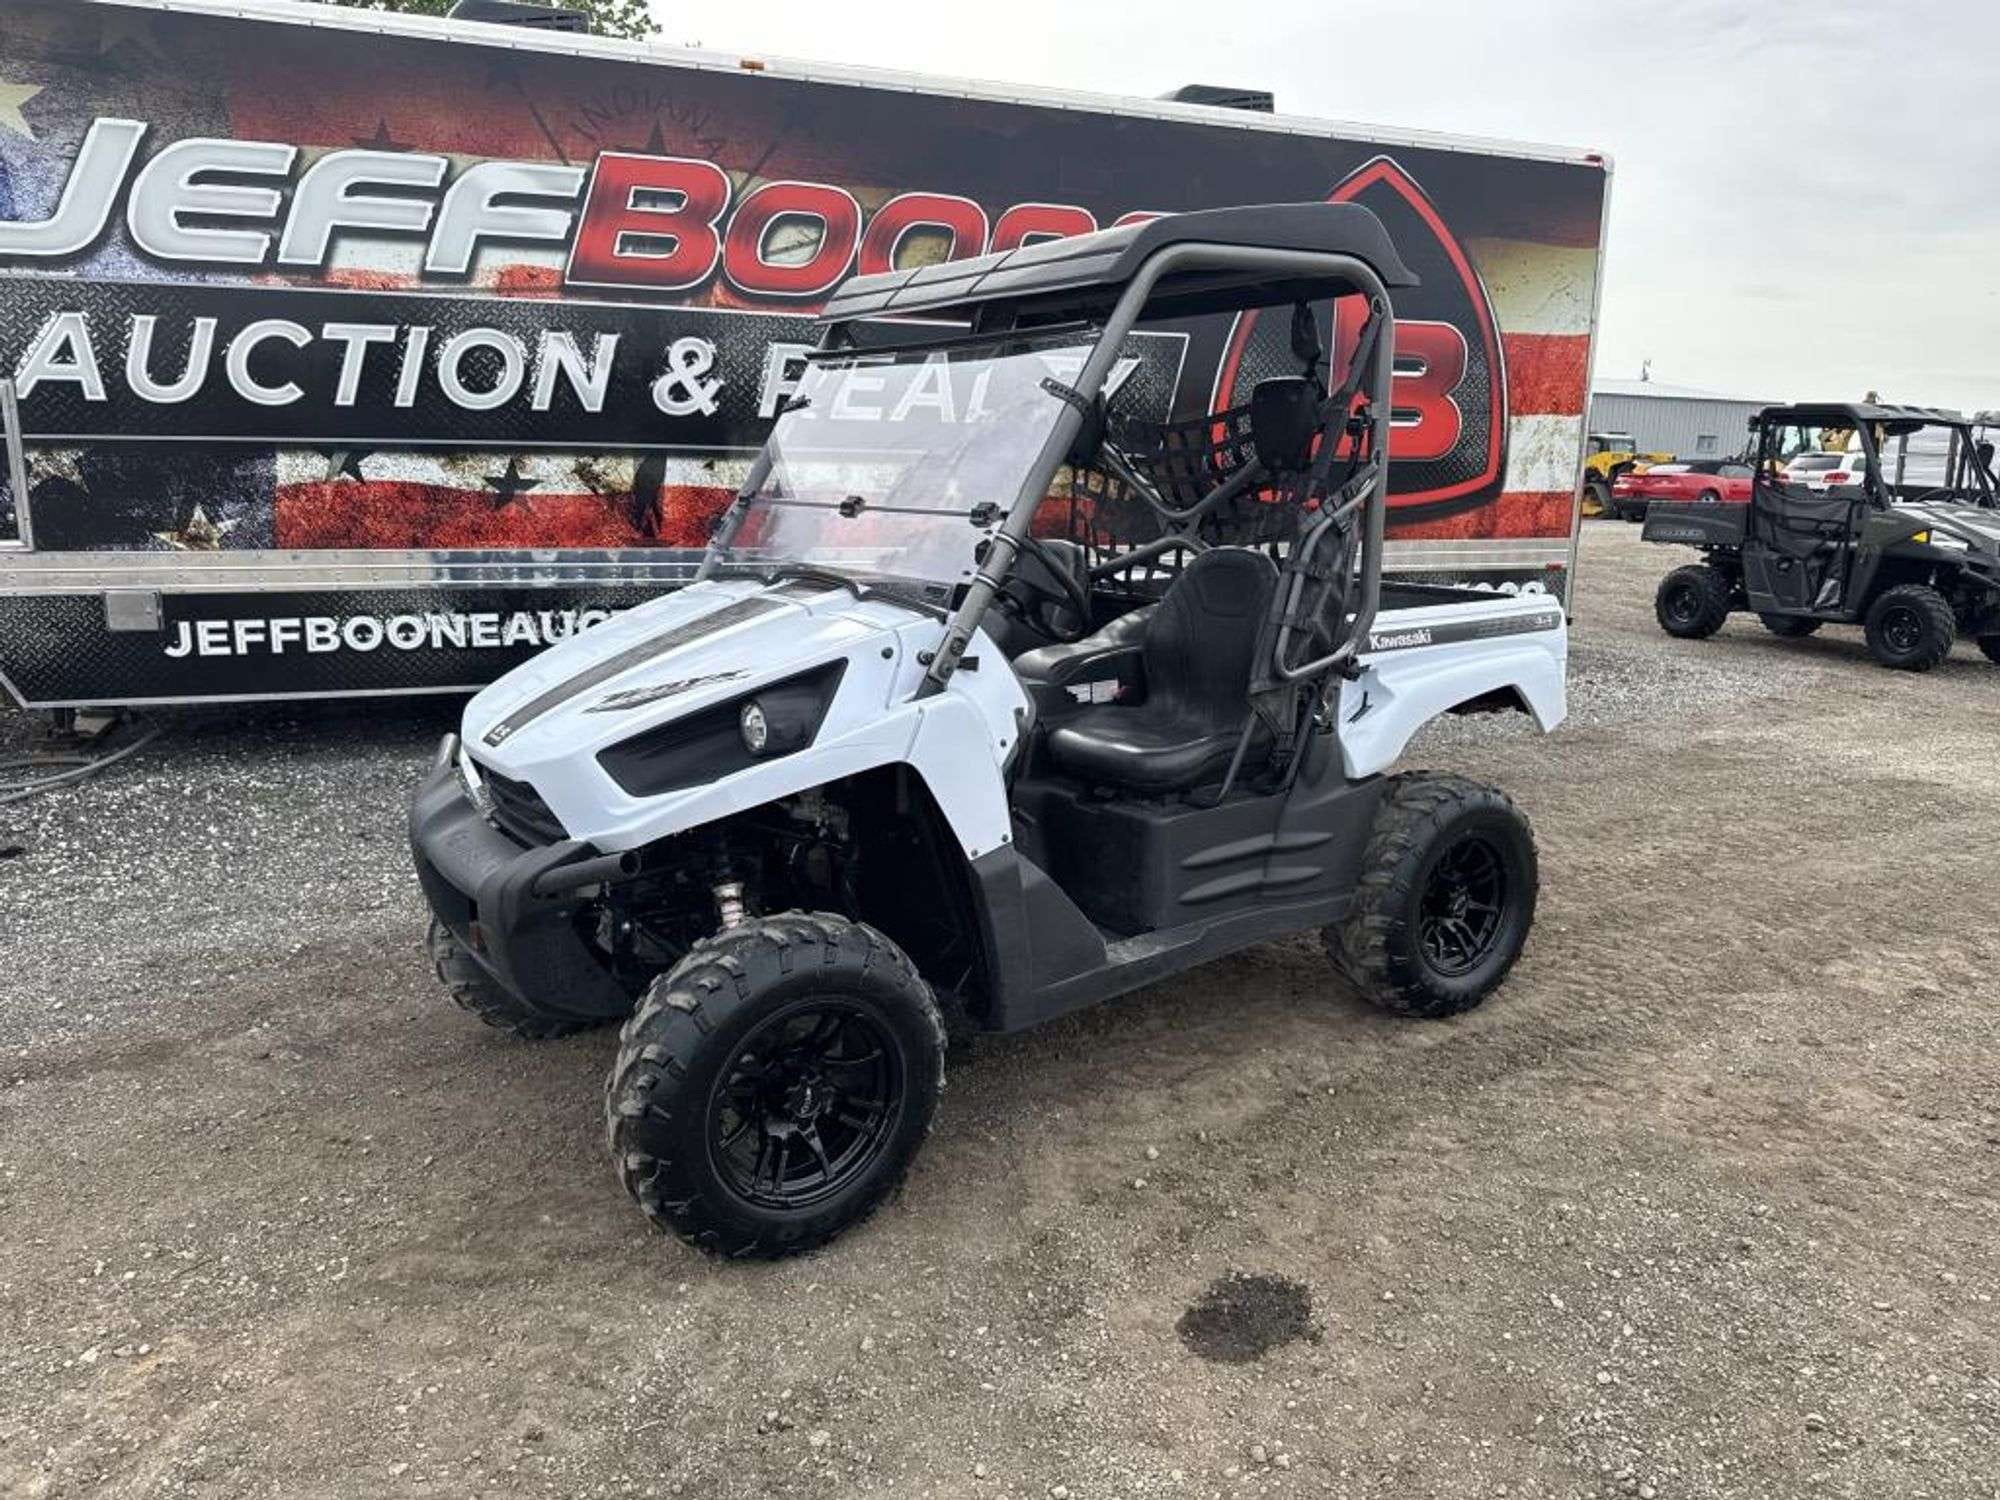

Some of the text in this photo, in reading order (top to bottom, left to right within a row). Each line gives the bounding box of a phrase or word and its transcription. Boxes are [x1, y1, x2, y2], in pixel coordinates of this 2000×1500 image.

[0, 117, 1163, 295] JEFFBOO
[14, 311, 618, 413] AUCTION
[652, 336, 725, 417] &
[1369, 629, 1432, 650] Kawasaki
